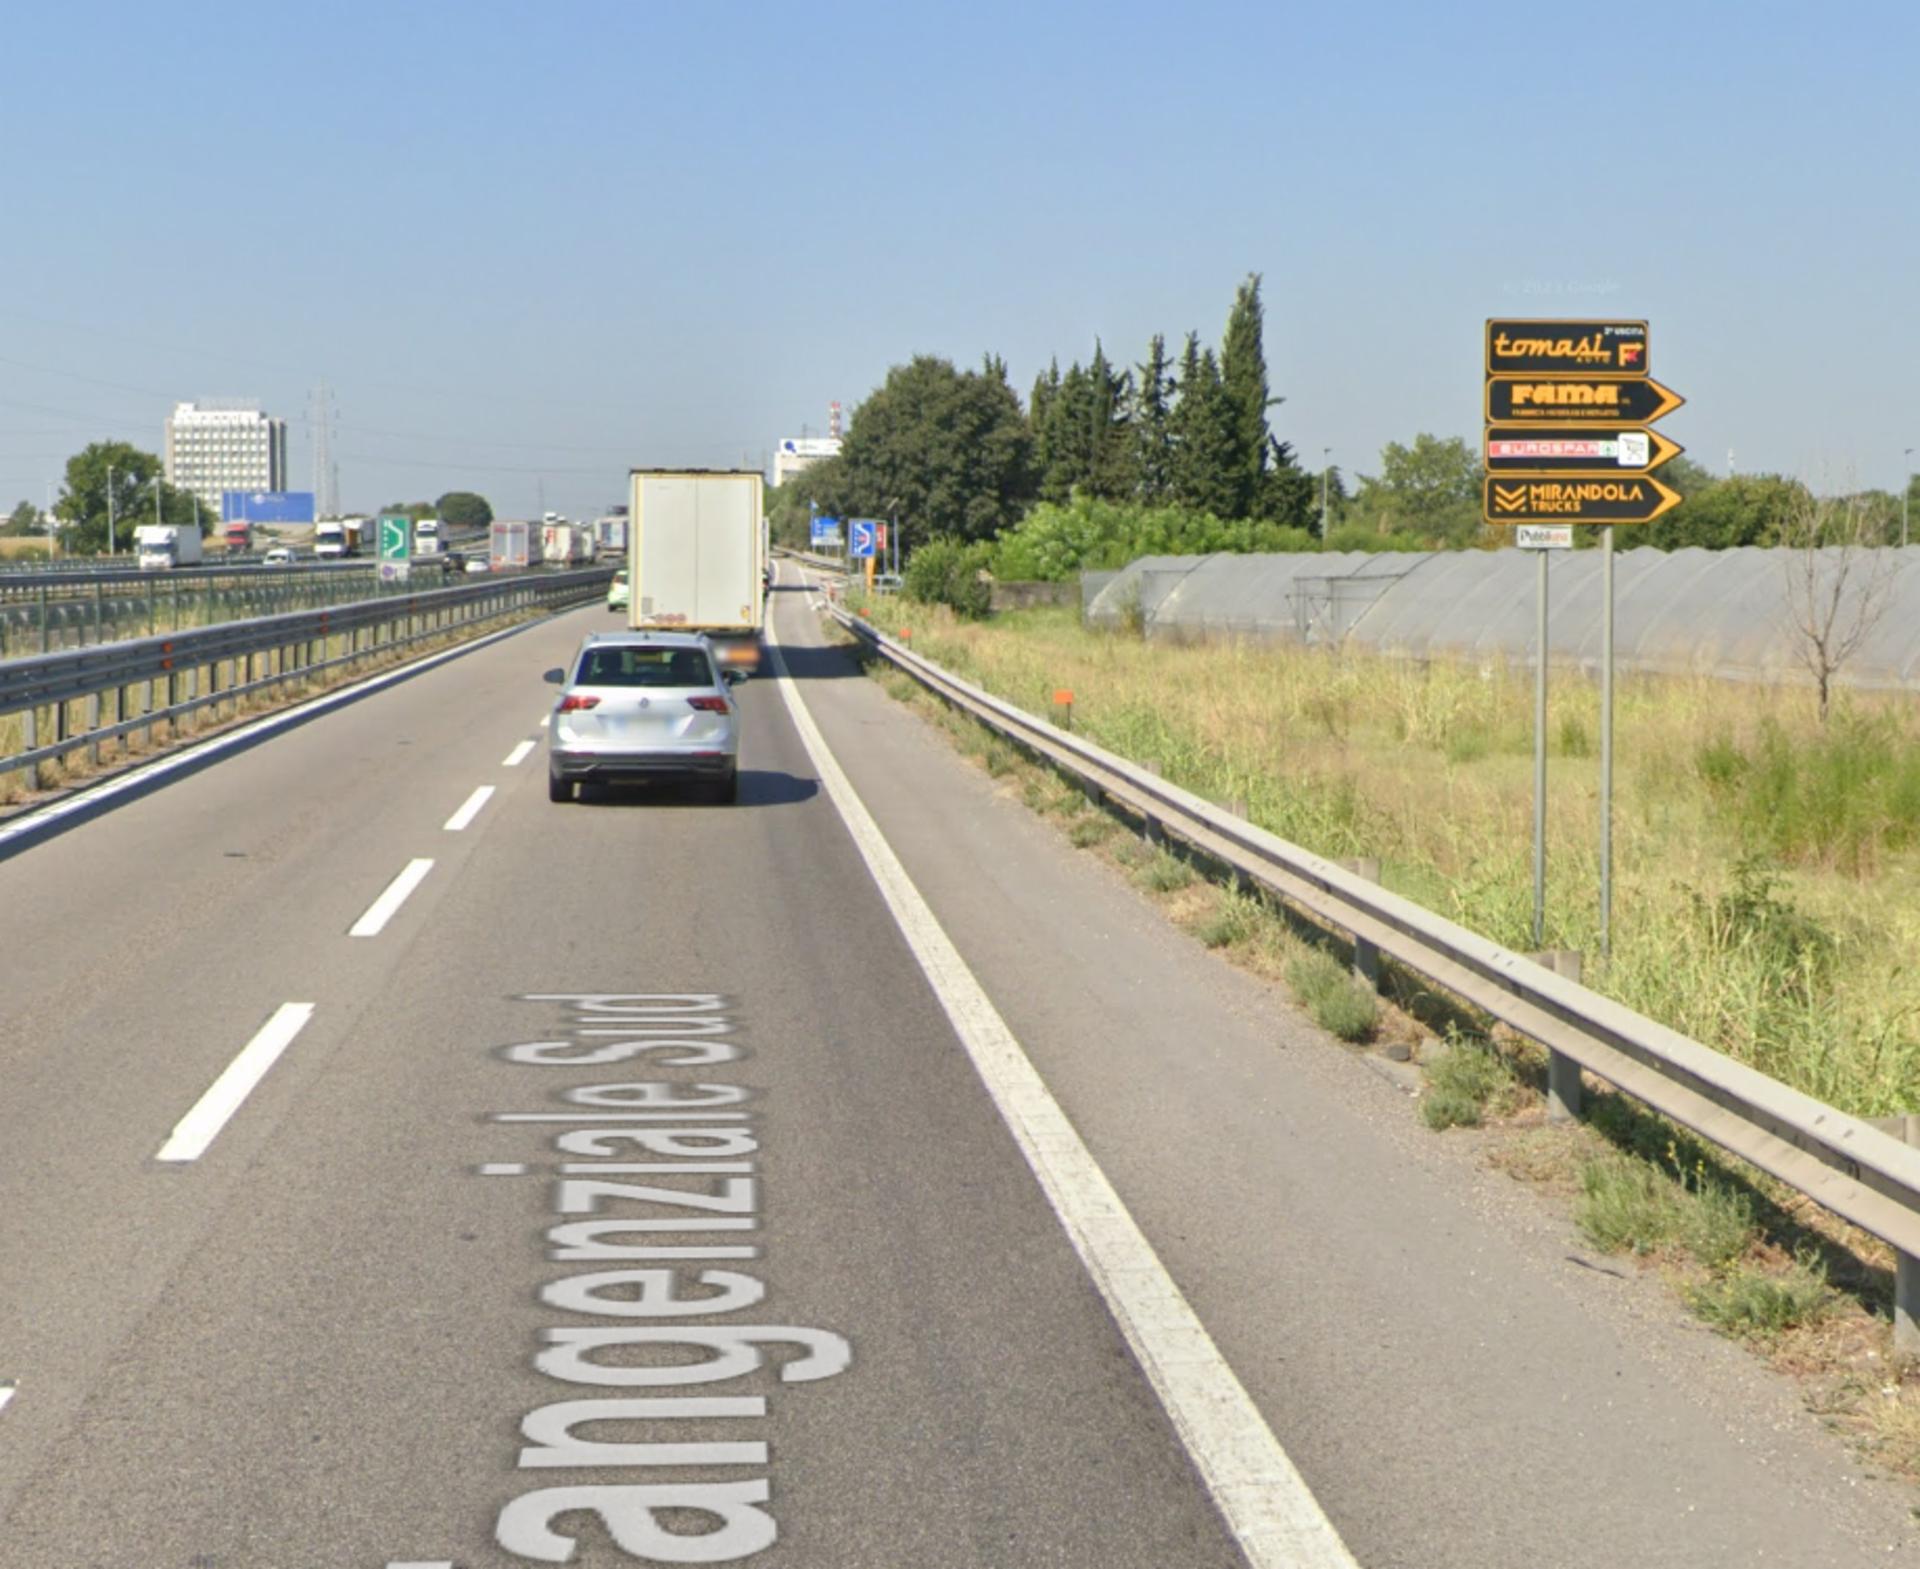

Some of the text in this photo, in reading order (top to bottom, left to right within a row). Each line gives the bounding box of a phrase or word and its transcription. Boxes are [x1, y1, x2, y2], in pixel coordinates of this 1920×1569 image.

[1494, 332, 1611, 358] tomasi
[1530, 484, 1644, 501] MIRANDOLA
[1531, 501, 1582, 513] TRUCKS
